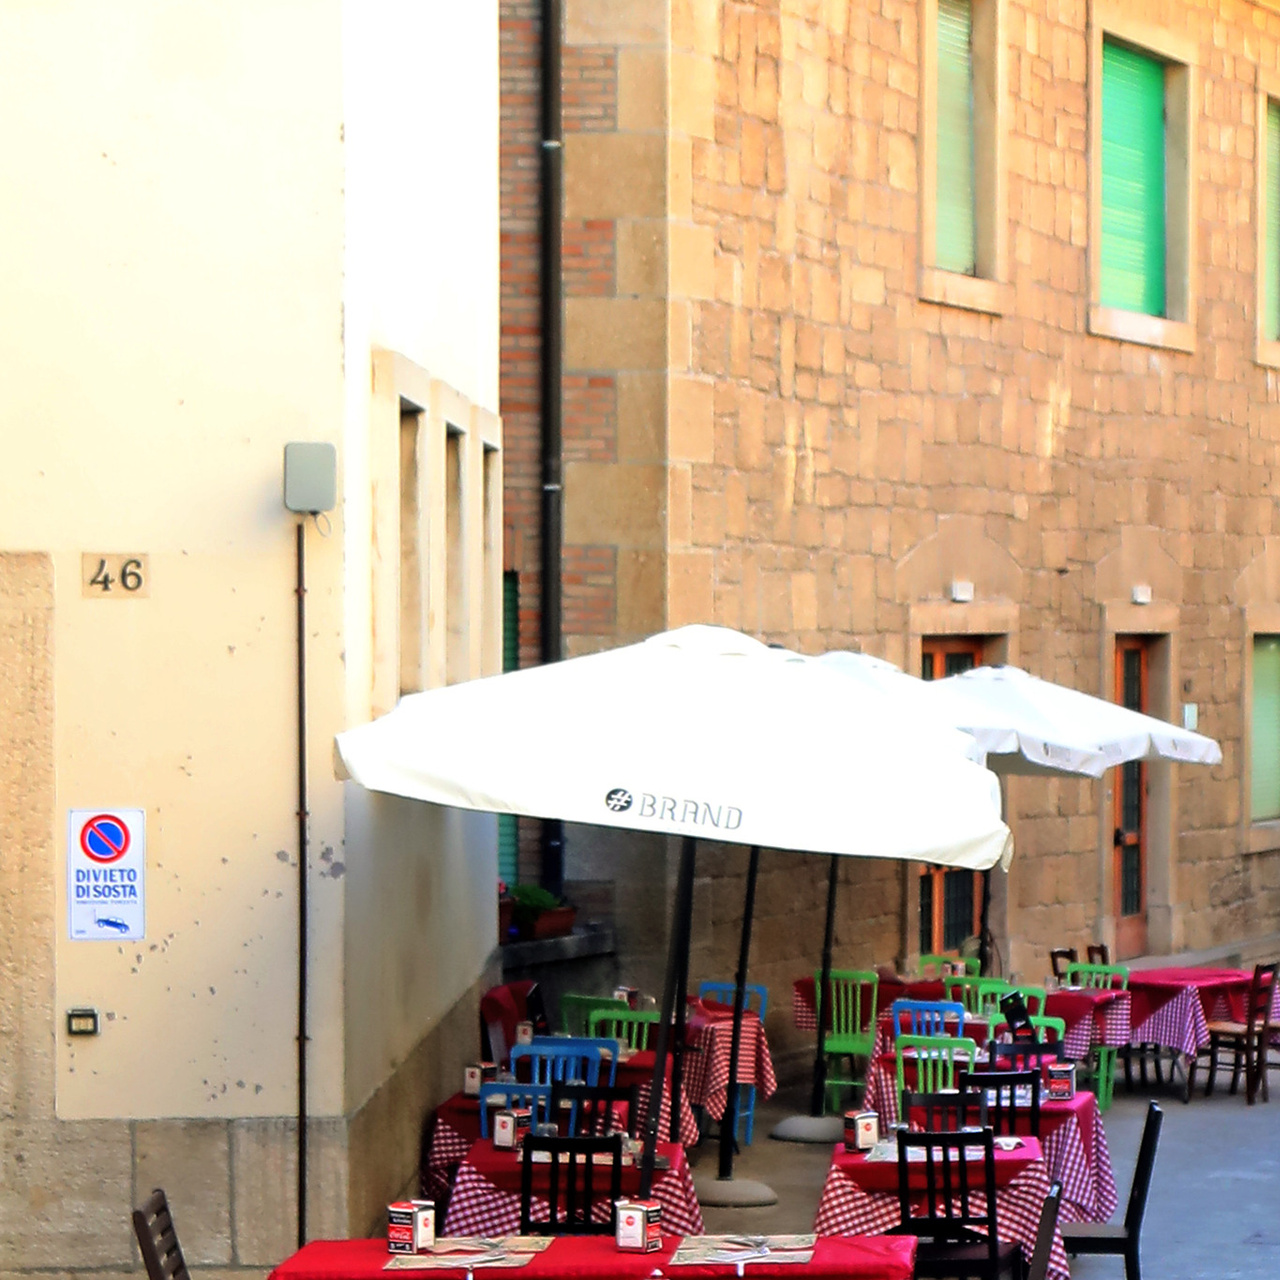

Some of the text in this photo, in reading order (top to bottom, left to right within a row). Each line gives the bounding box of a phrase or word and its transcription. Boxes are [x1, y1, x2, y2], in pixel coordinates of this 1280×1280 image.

[89, 558, 142, 591] 46
[638, 792, 743, 830] BRAND
[76, 869, 137, 882] DIVIETO
[76, 884, 138, 898] DI SOSTA
